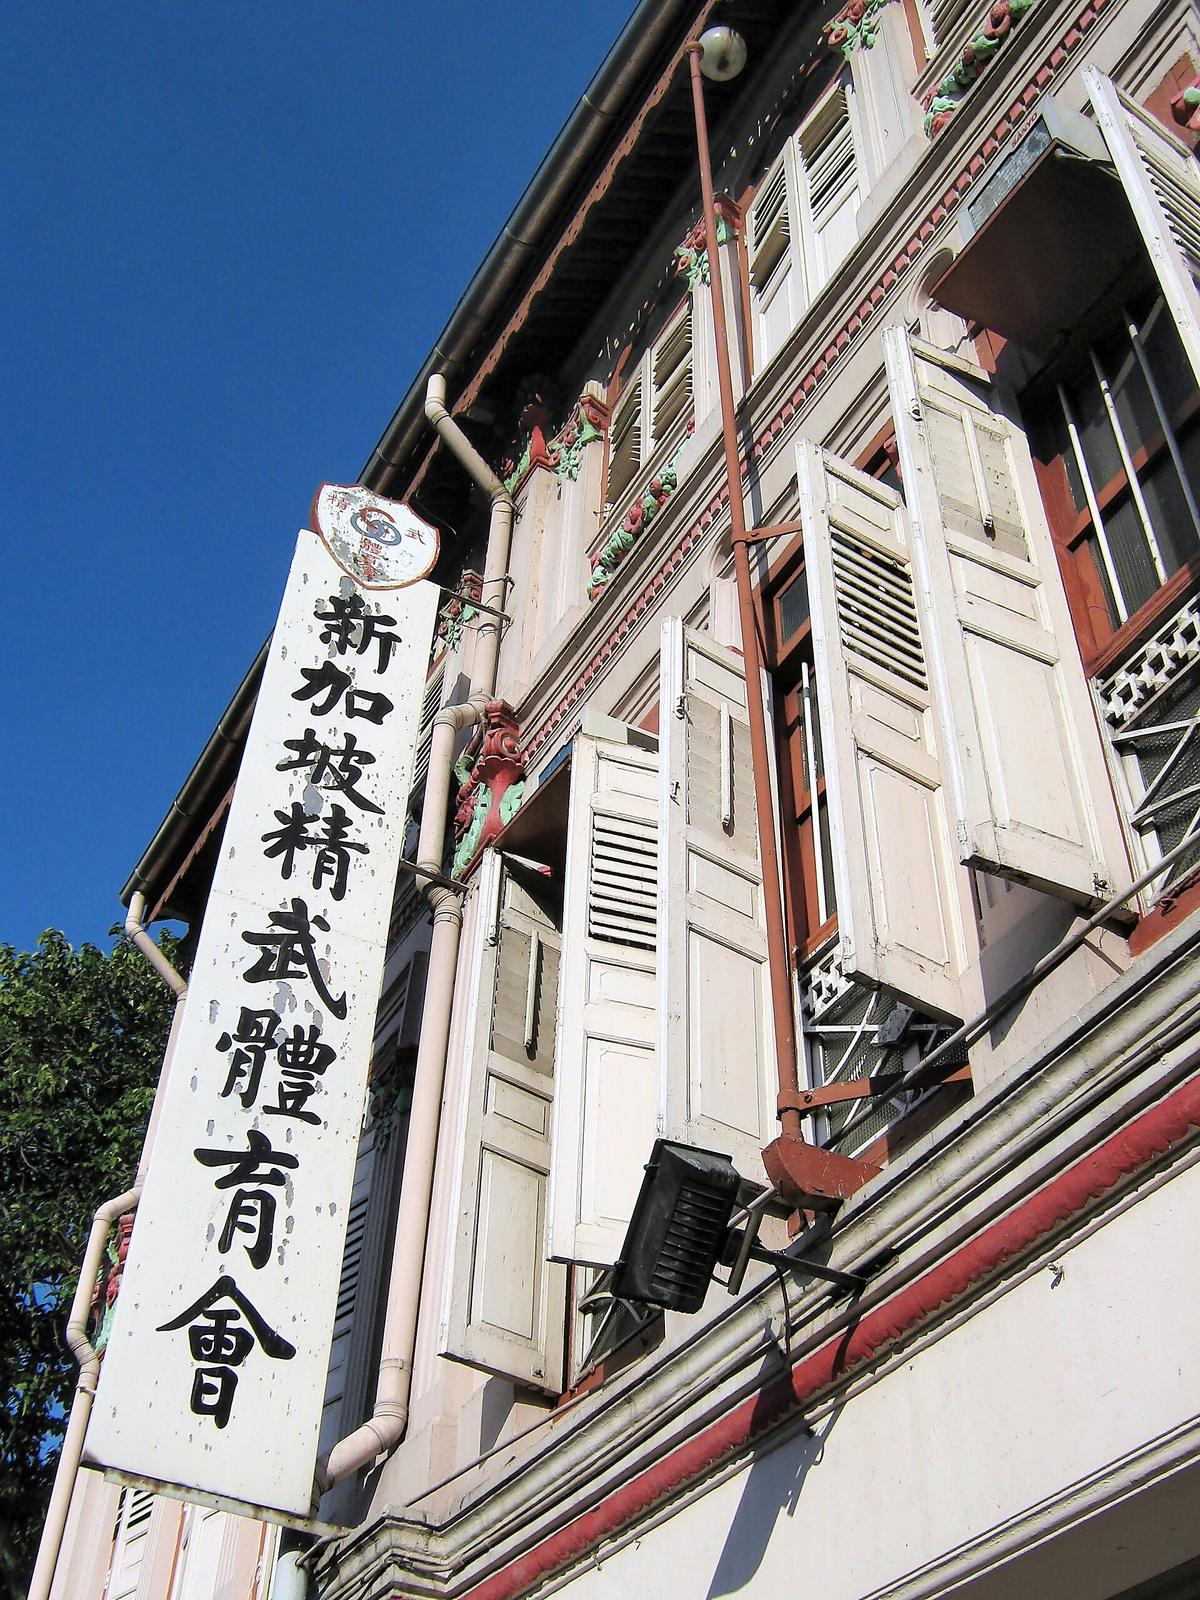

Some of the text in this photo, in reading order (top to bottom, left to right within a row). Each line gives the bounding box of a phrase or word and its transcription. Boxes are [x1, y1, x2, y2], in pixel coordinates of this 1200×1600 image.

[1011, 112, 1038, 148] SANYO
[156, 595, 402, 1429] 新加坡精武體育會
